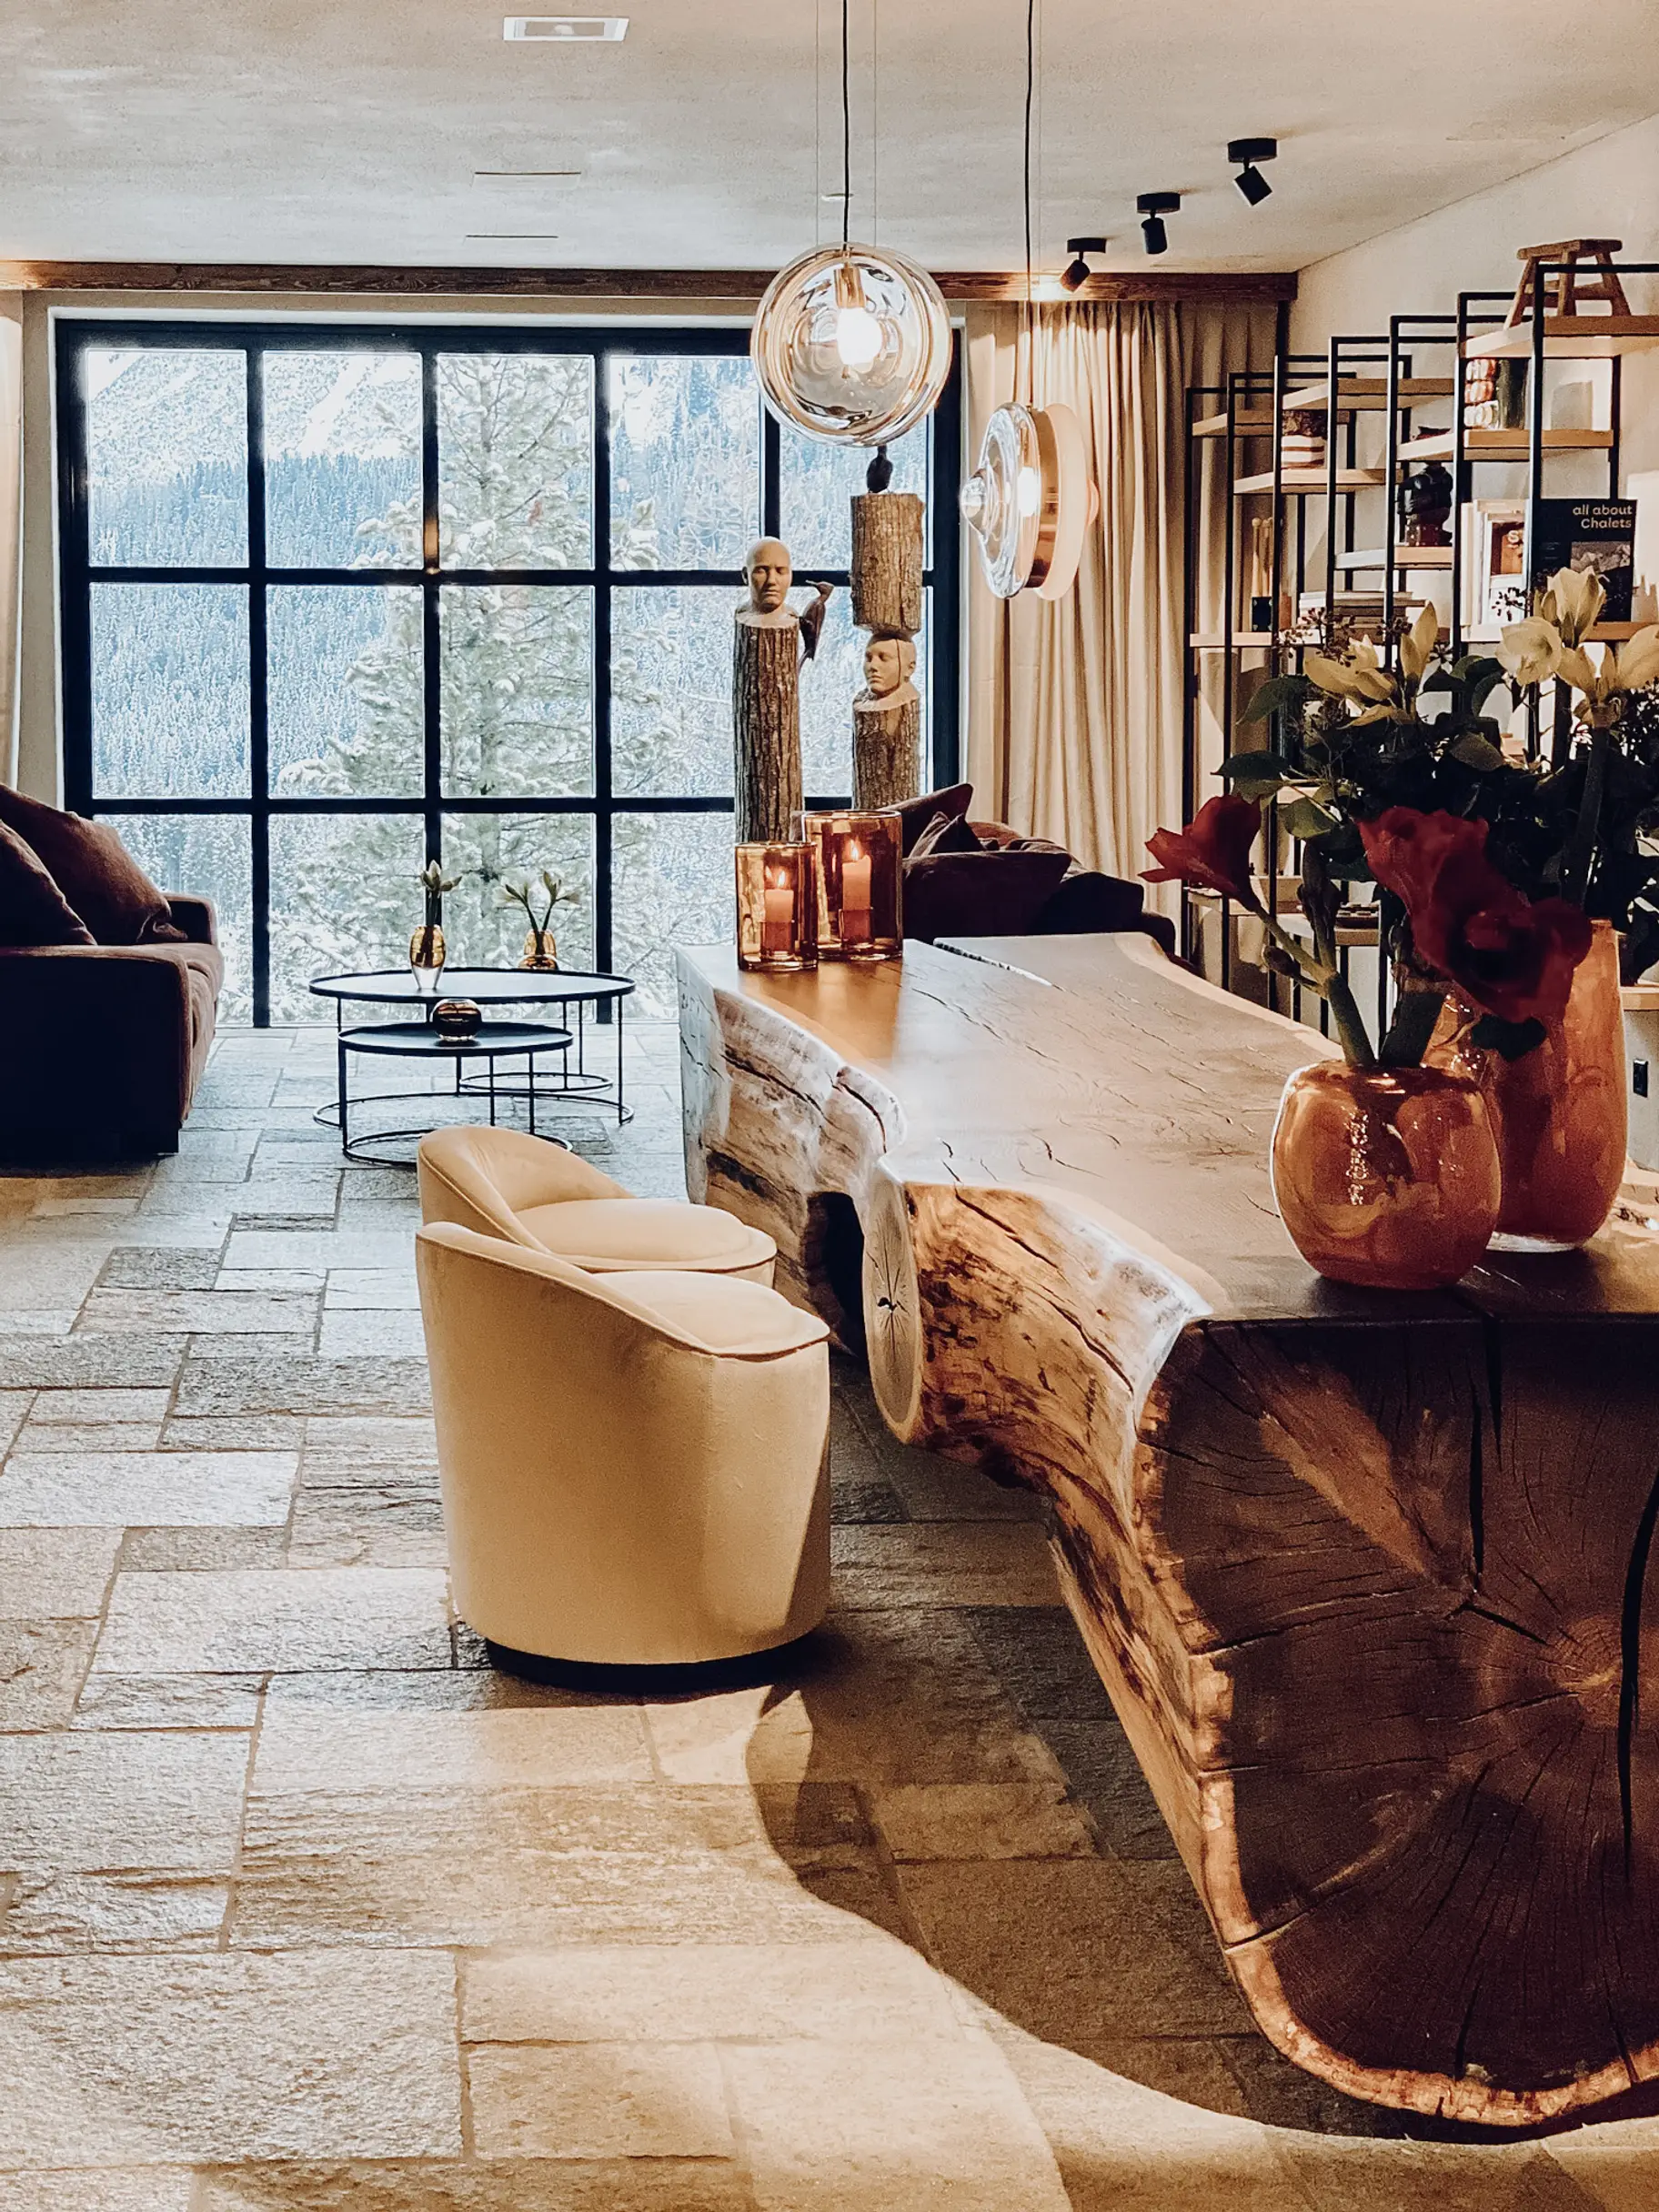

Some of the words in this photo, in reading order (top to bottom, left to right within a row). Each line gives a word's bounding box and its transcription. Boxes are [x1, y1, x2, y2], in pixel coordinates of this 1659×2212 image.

[1573, 504, 1589, 516] all
[1593, 504, 1633, 516] about
[1581, 517, 1632, 529] Chalets
